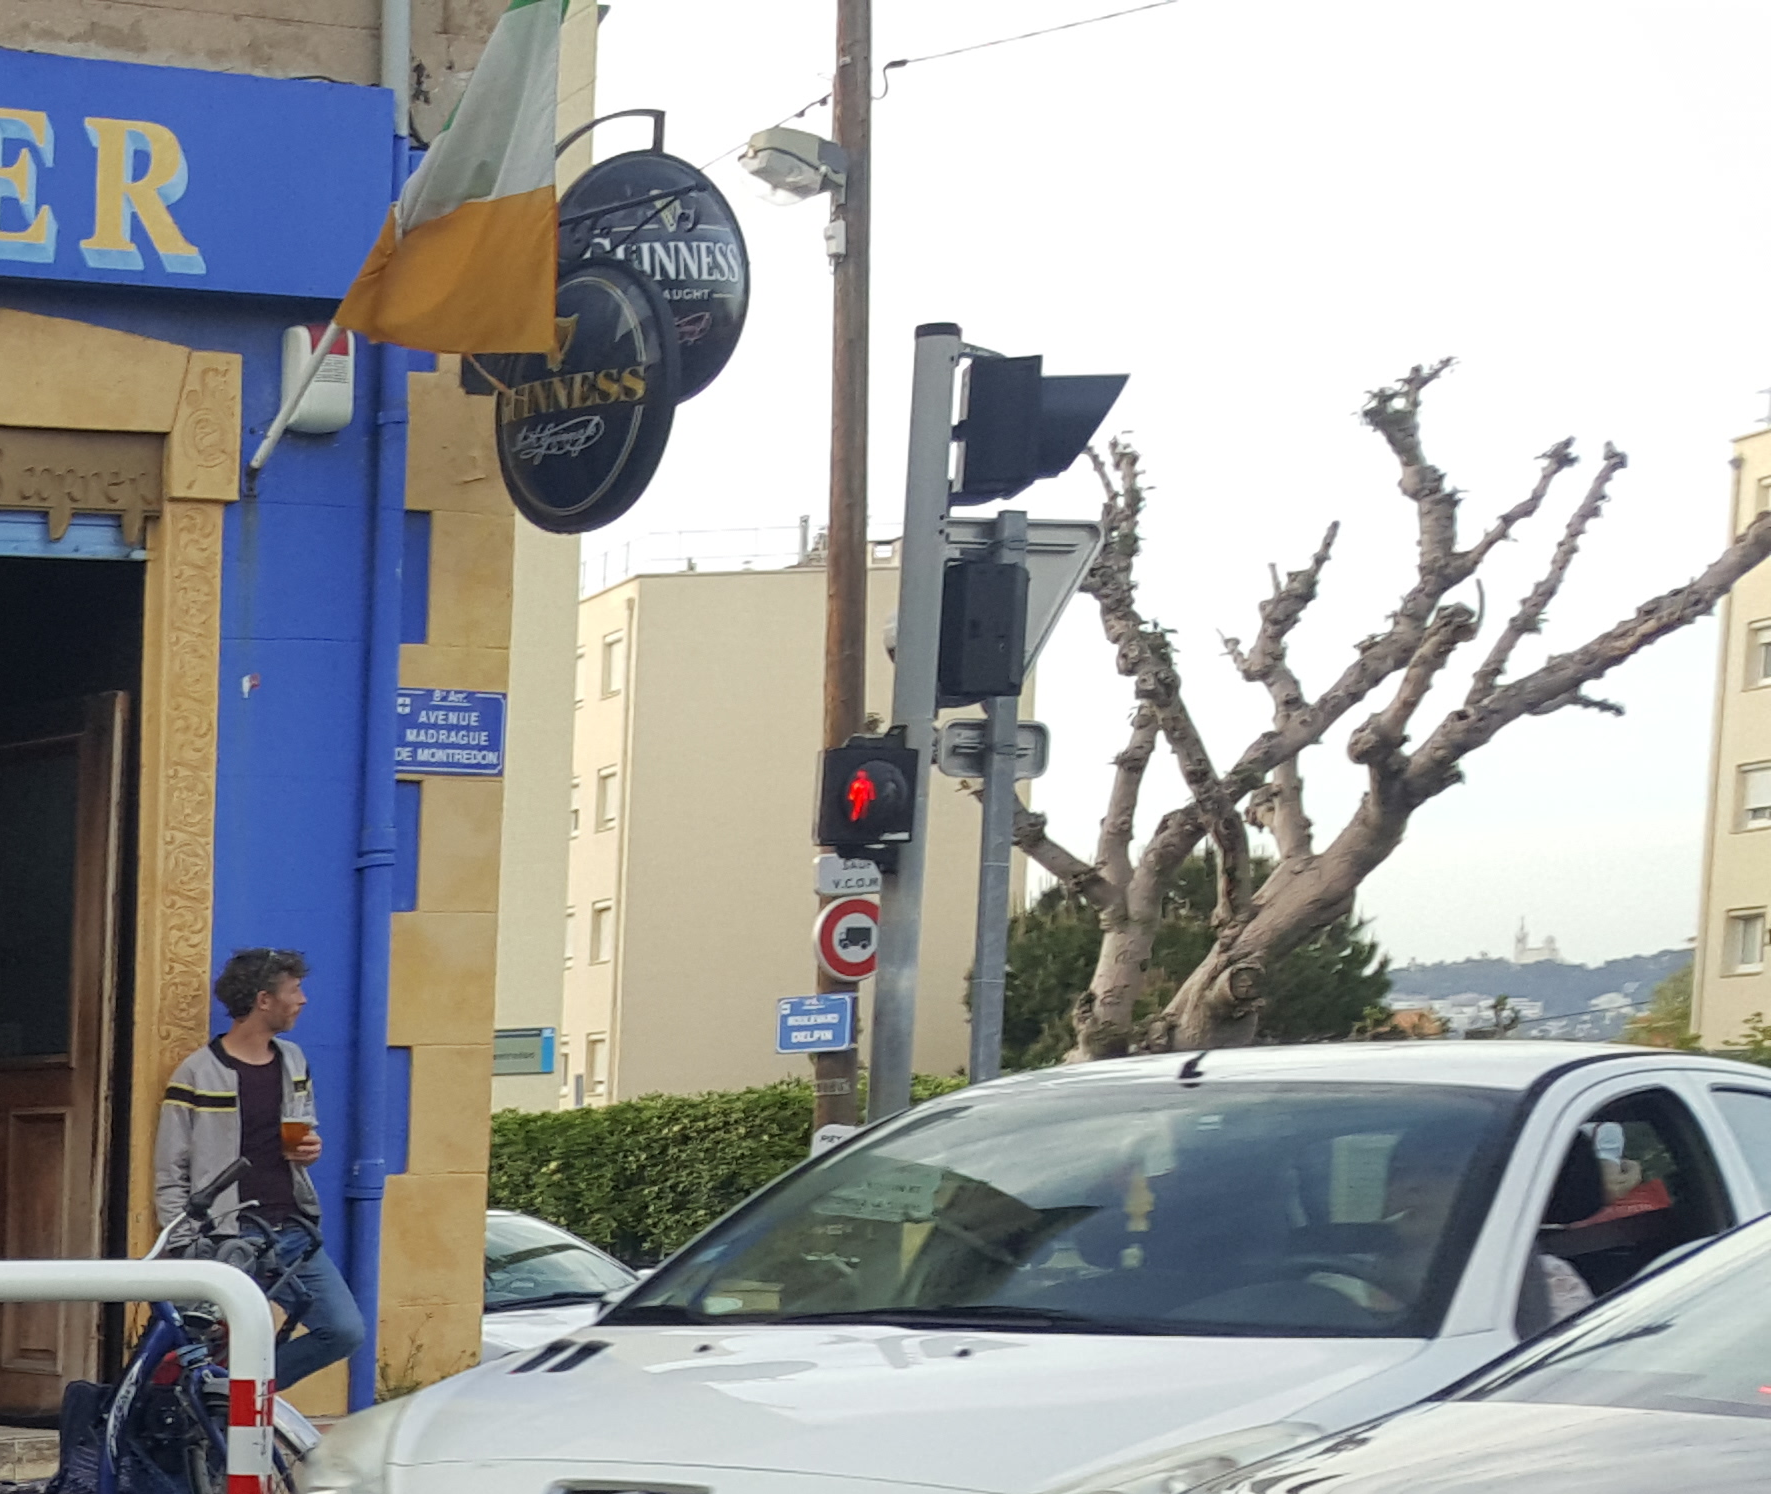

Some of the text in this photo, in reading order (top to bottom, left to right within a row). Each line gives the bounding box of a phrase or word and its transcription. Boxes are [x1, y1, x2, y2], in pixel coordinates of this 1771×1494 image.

[581, 237, 740, 282] UINNESS
[502, 365, 647, 424] INNESS
[418, 710, 480, 726] AVENUE
[405, 728, 489, 746] MADRAGUE
[395, 747, 499, 765] DE MONTREDON
